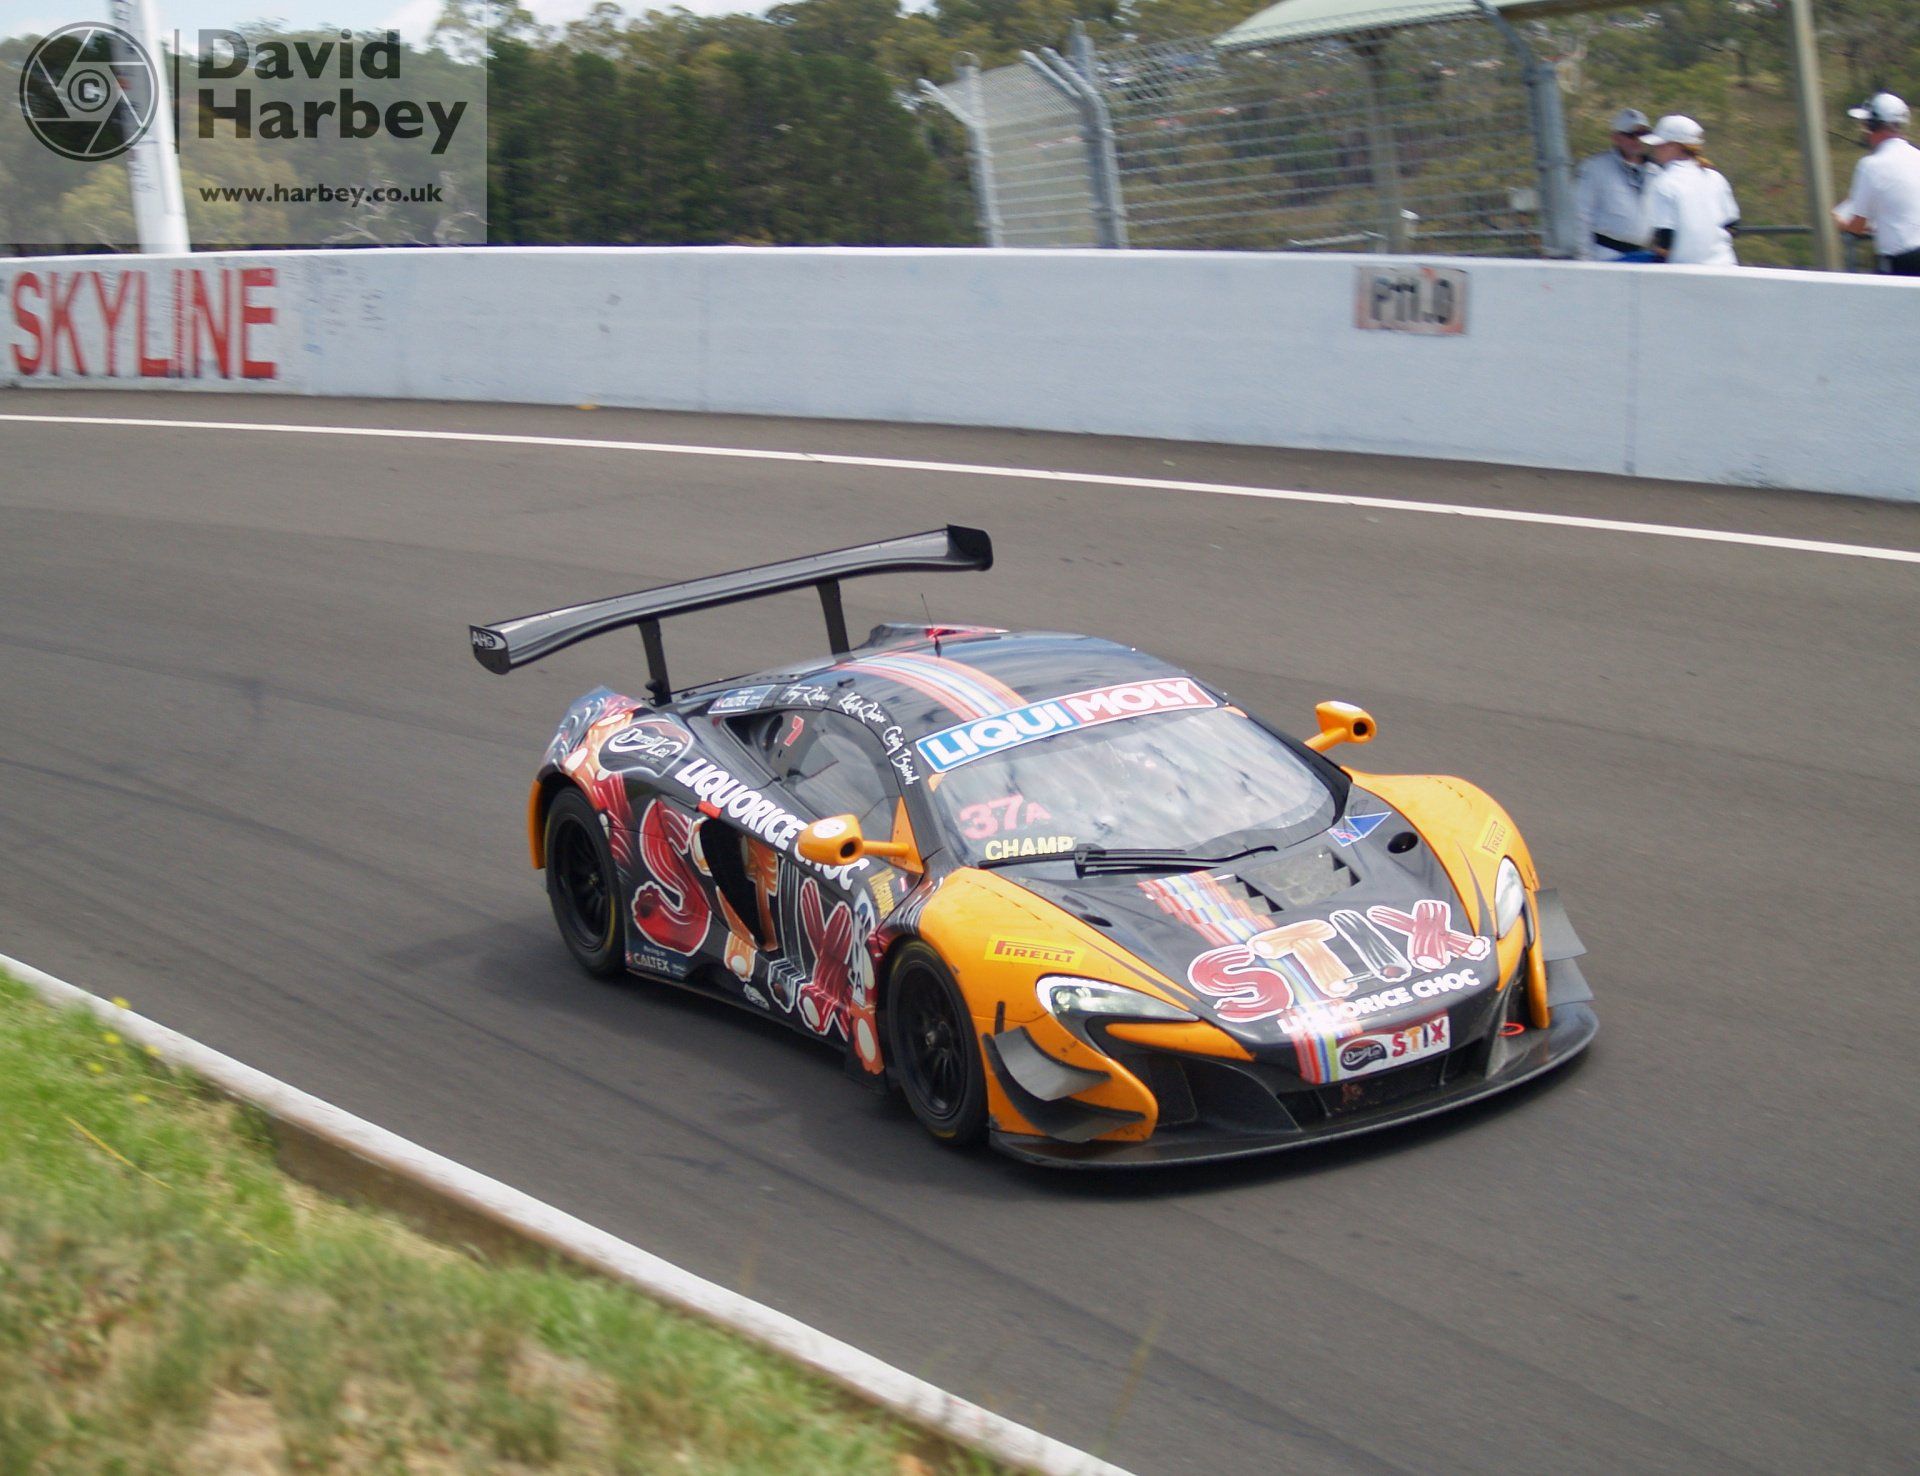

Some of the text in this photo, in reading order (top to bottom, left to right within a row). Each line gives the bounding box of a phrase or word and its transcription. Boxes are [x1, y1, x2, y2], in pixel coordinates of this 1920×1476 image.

[11, 268, 276, 379] SKYLINE
[926, 681, 1199, 766] LIQUI MOLY
[674, 758, 809, 850] LIQUORICE
[985, 836, 1075, 860] CHAMP
[994, 940, 1075, 963] PIRELLI
[1187, 900, 1490, 1022] STIX
[1412, 969, 1480, 997] CHOC
[1392, 1019, 1446, 1057] STIX
